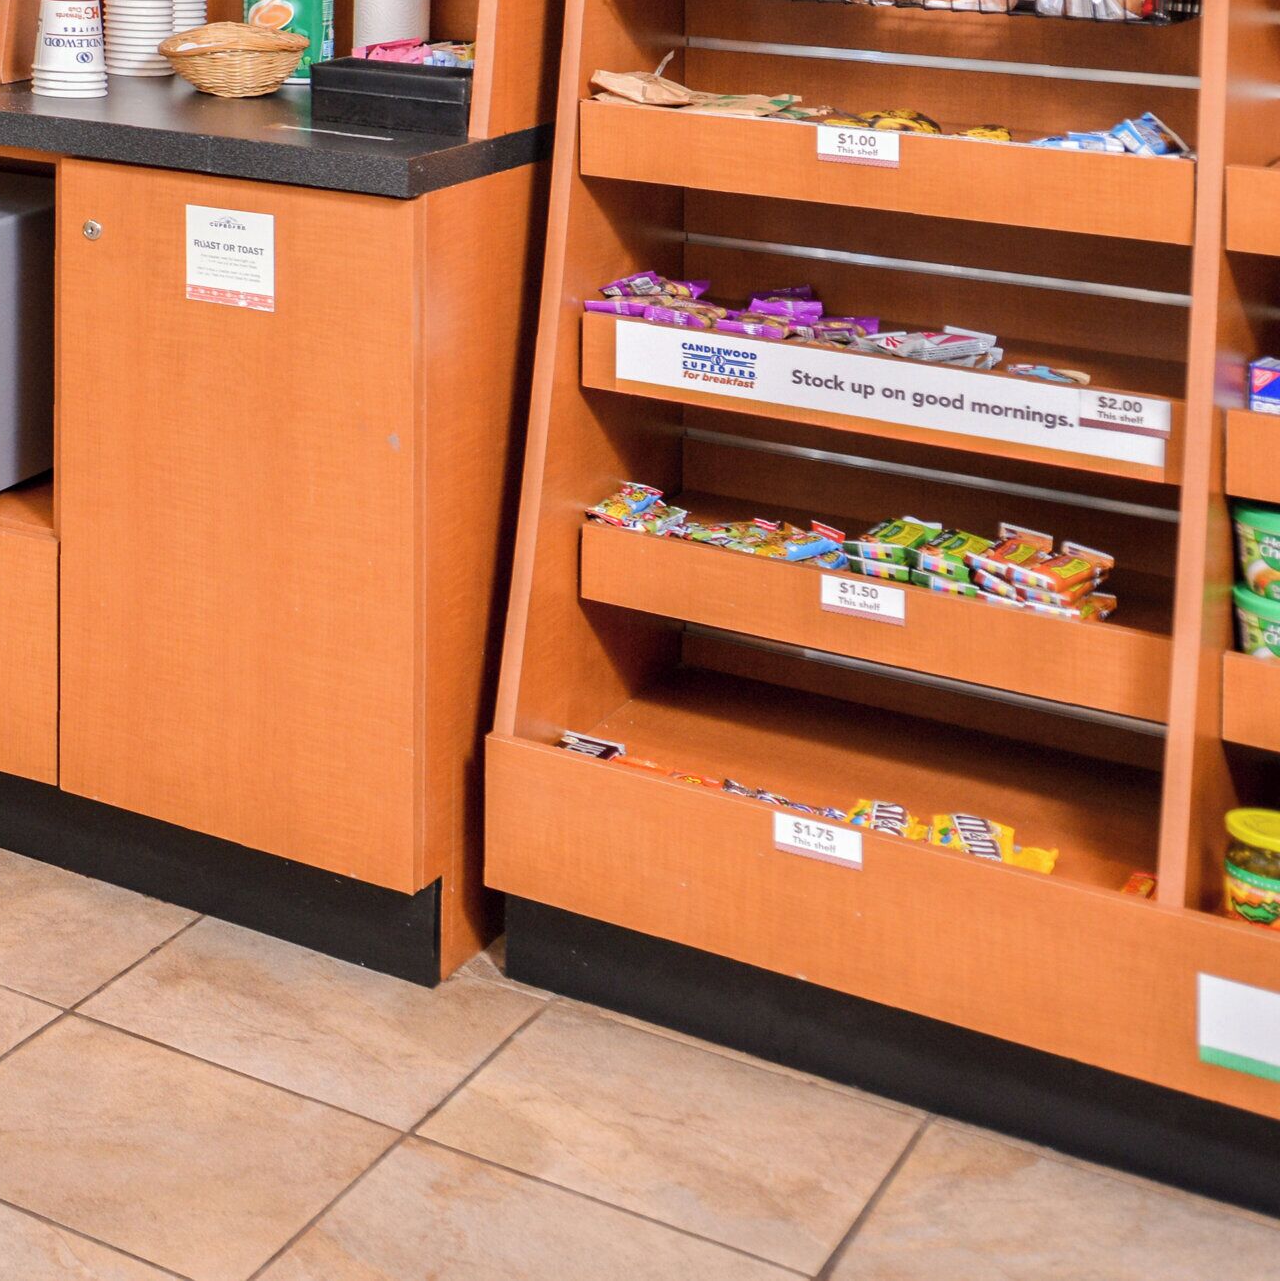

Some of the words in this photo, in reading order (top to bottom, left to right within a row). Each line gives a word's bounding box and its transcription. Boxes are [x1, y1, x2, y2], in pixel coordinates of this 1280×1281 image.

[837, 133, 877, 147] $1.00
[836, 145, 856, 155] This
[857, 148, 879, 157] shelf
[193, 238, 221, 250] ROAST
[223, 242, 236, 253] OR
[237, 245, 264, 256] TOAST
[681, 342, 758, 361] CANDLEWOOD
[682, 360, 757, 379] CUPBOARD
[683, 370, 700, 382] for
[701, 372, 755, 389] breakfast
[791, 369, 845, 392] Stock
[851, 381, 875, 400] up
[881, 386, 906, 402] on
[912, 391, 965, 414] good
[970, 399, 1075, 429] mornings.
[1097, 395, 1143, 414] $2.00
[1096, 410, 1122, 423] This
[1122, 412, 1144, 426] shelf
[839, 581, 879, 600] $1.50
[837, 596, 857, 609] This
[858, 599, 881, 612] shelf
[792, 821, 835, 843] $1.75
[791, 835, 813, 850] This
[813, 840, 837, 855] shelf
